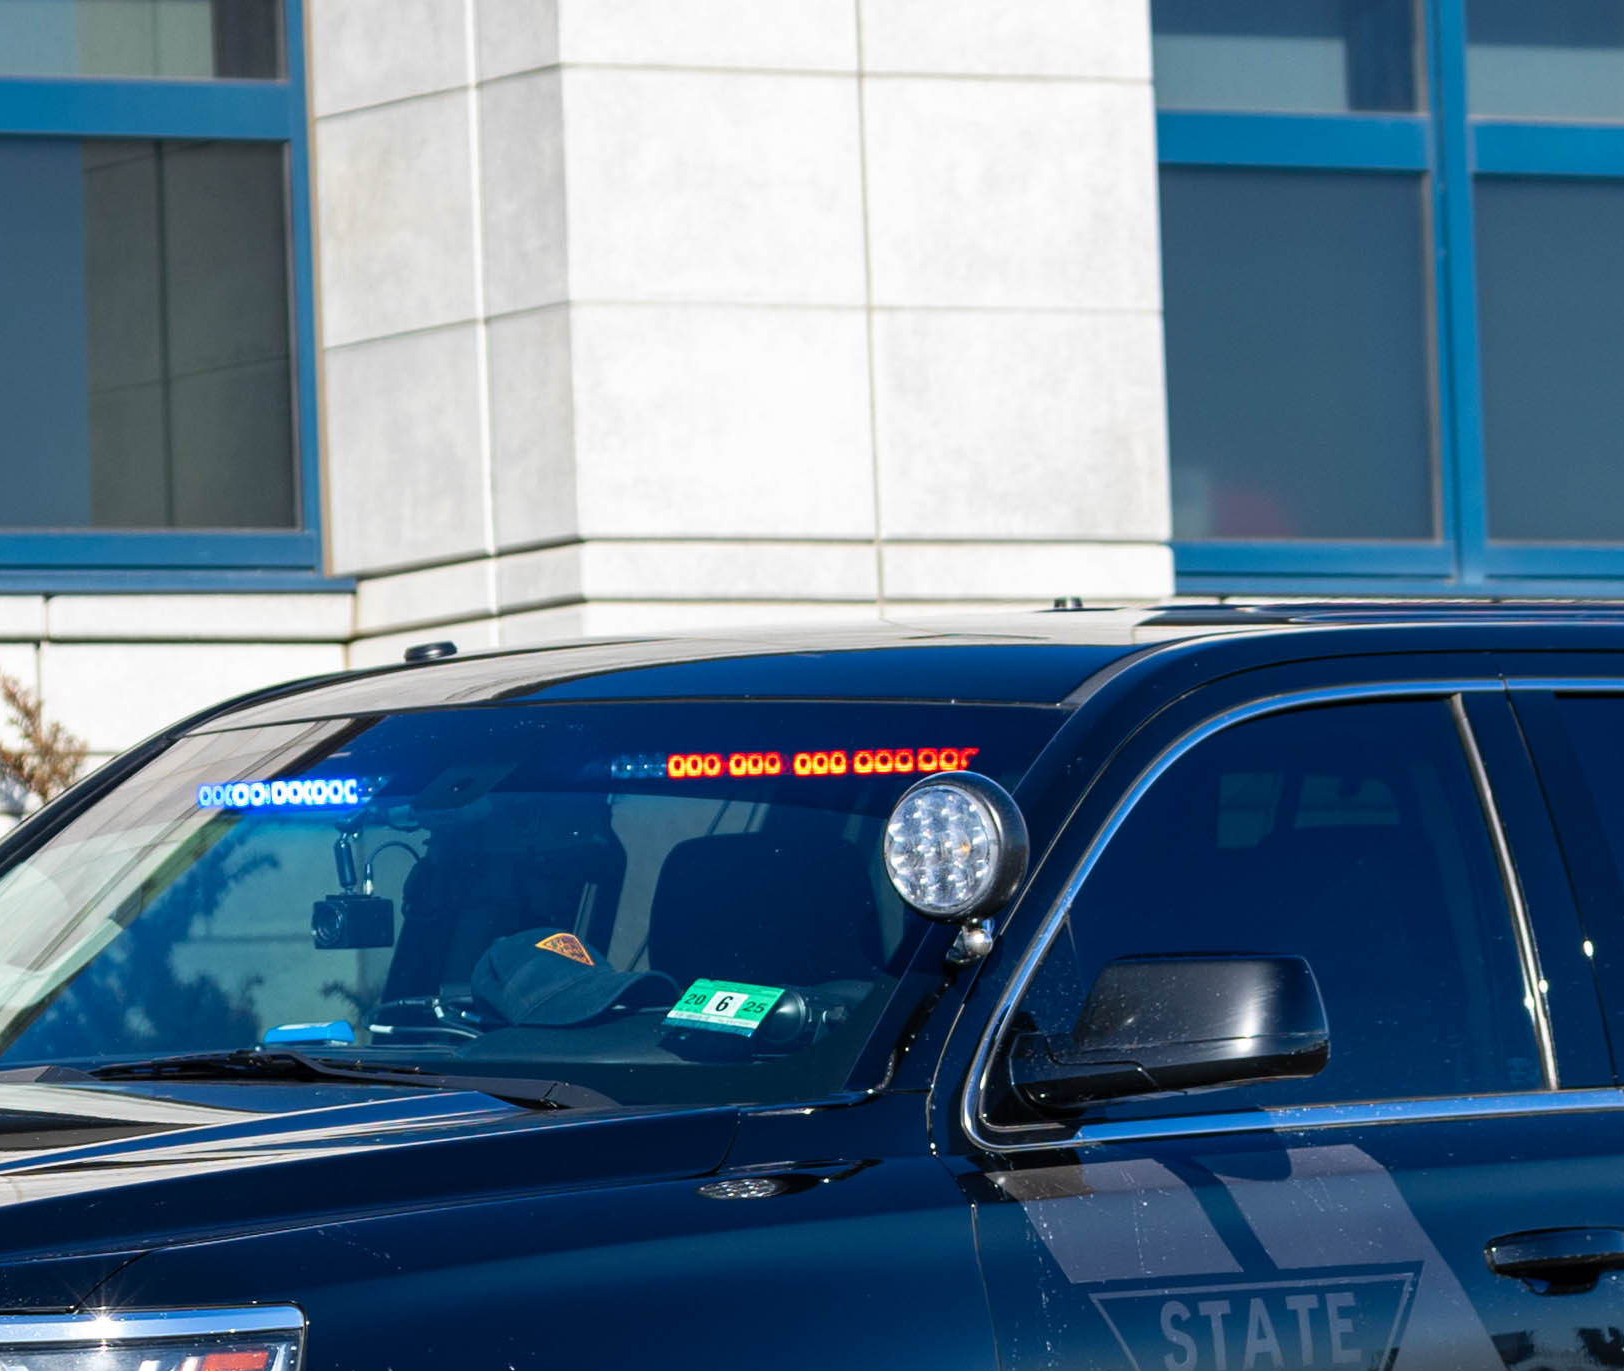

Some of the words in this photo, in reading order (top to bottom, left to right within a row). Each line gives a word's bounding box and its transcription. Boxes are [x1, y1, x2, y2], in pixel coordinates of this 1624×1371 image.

[684, 993, 707, 1006] 20
[715, 996, 734, 1012] 6
[742, 1001, 768, 1014] 25
